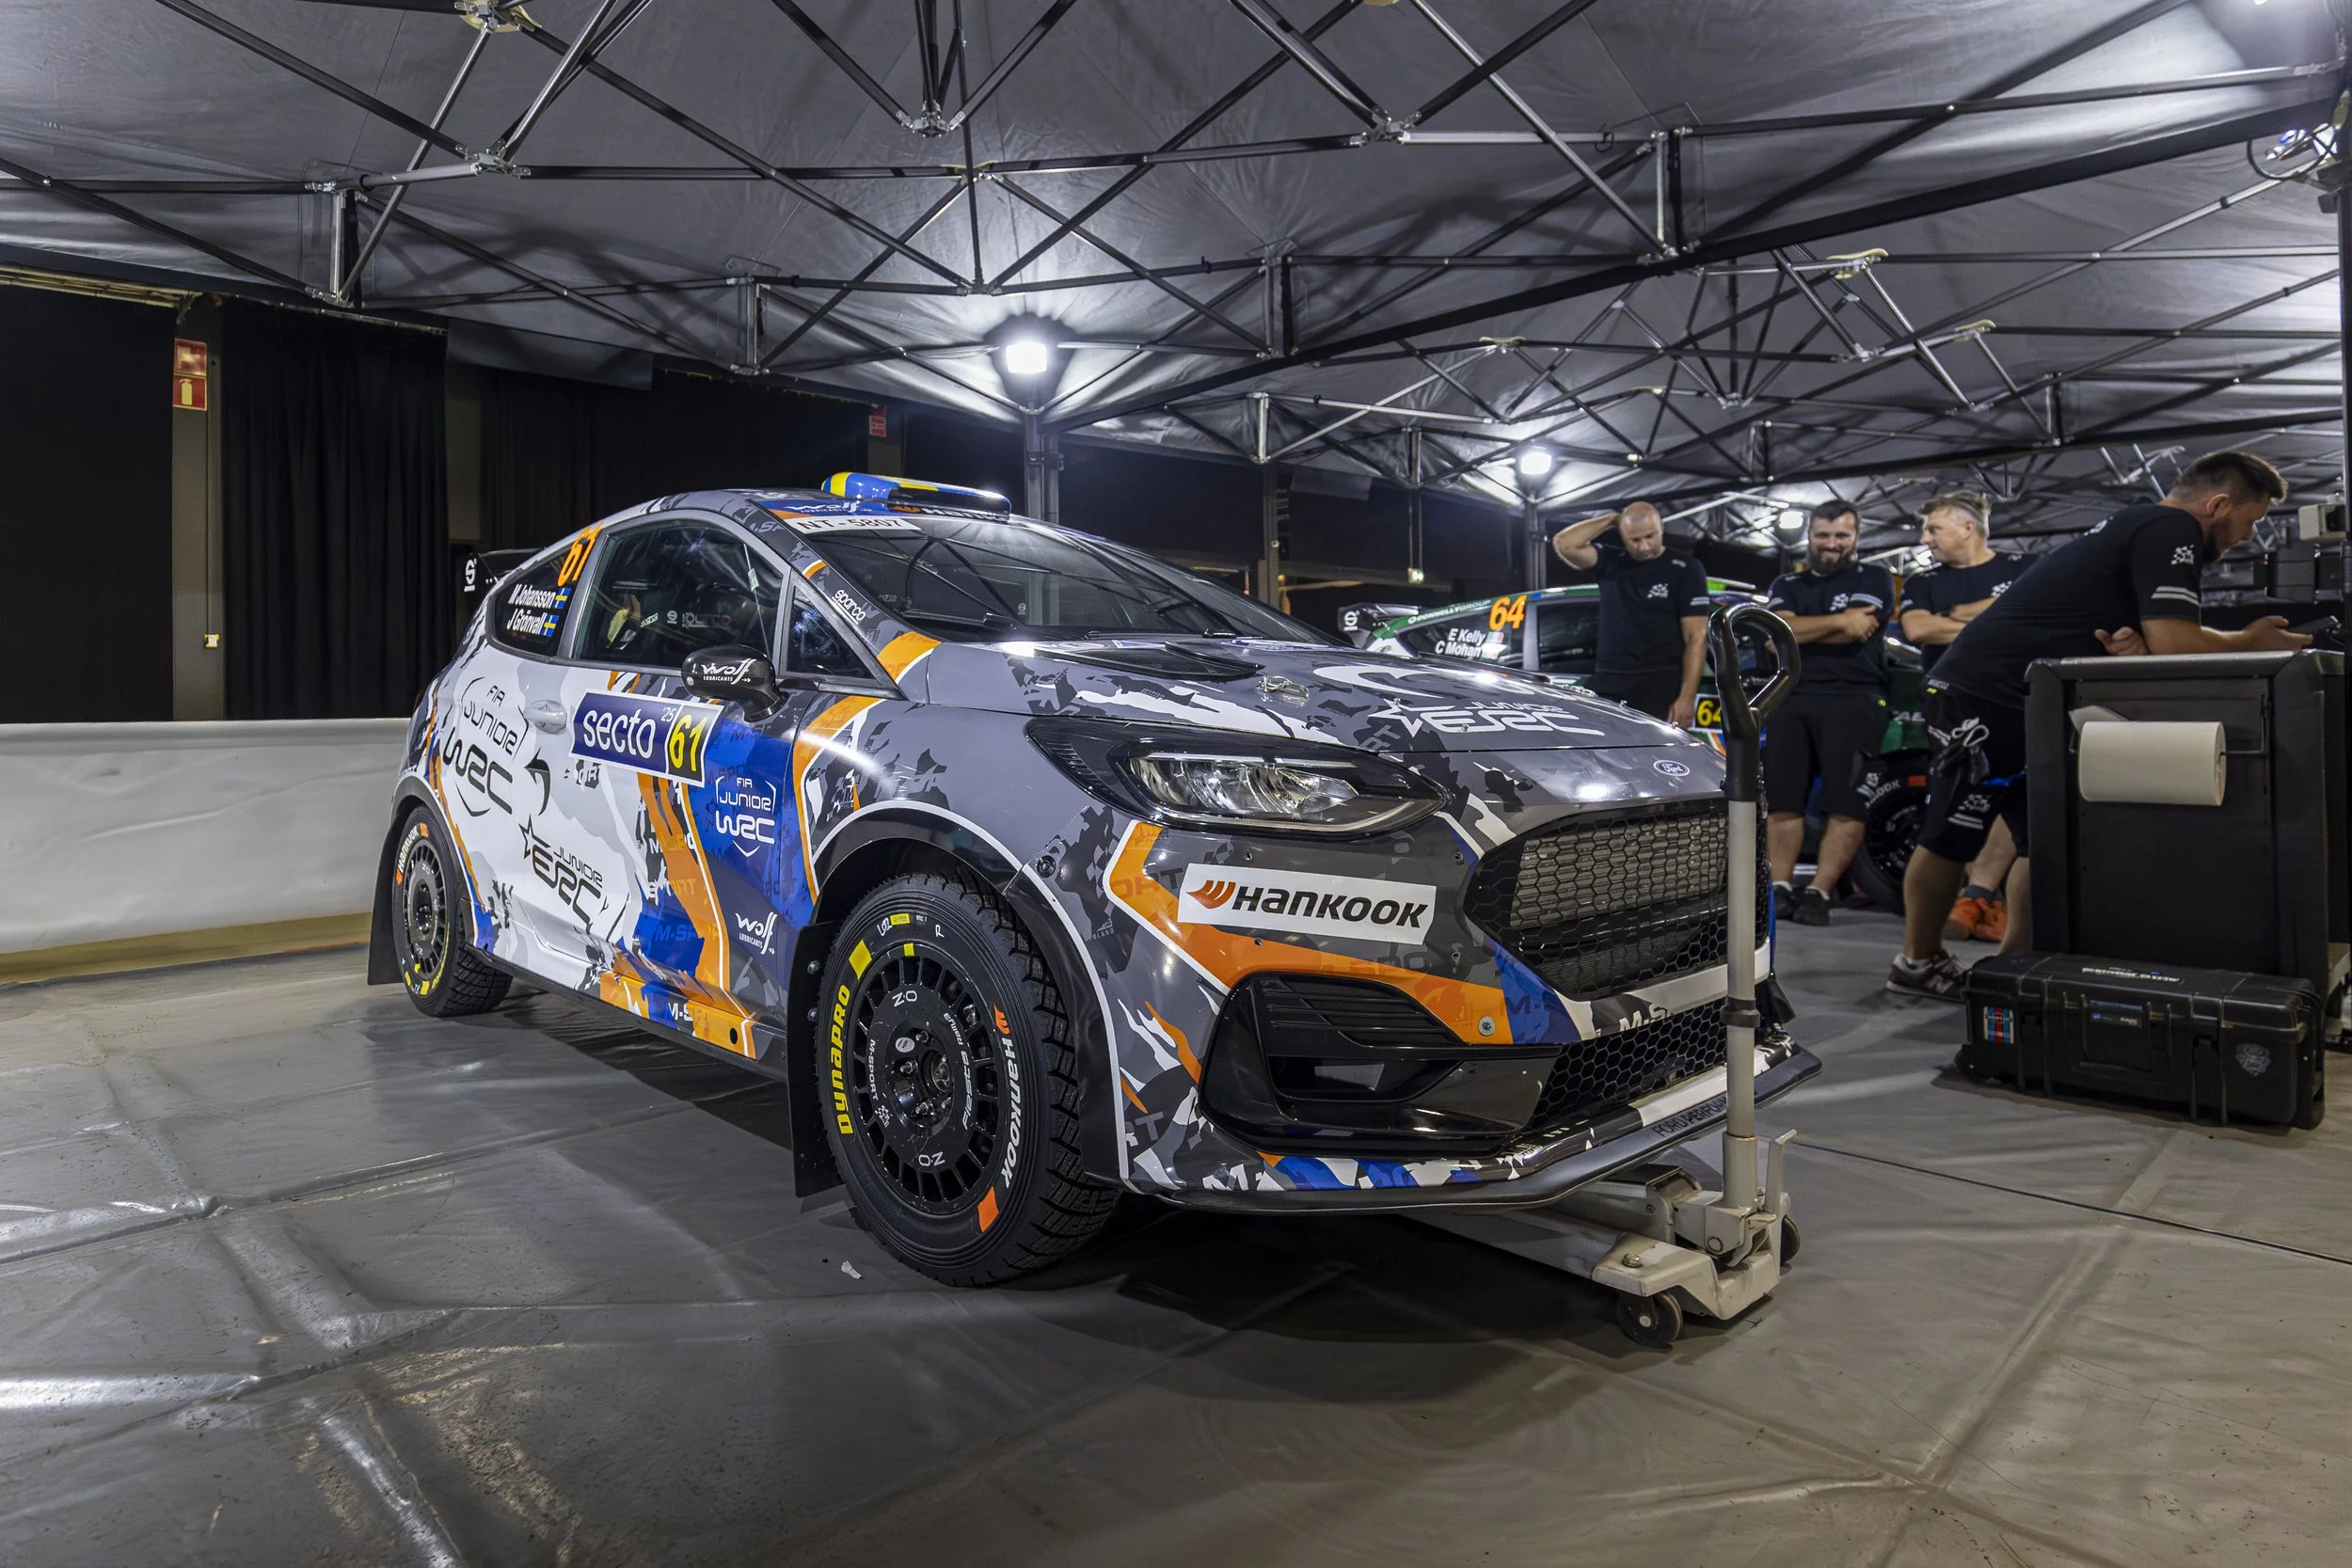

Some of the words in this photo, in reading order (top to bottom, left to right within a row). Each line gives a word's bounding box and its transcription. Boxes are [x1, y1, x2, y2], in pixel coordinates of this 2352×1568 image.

[515, 584, 557, 610] Johansson
[834, 589, 866, 623] sparco
[1488, 594, 1527, 631] 64
[1435, 641, 1446, 654] C
[1448, 627, 1458, 641] E
[1458, 628, 1486, 646] Kelly
[701, 657, 756, 685] Wolf
[486, 685, 506, 707] FIA
[464, 700, 518, 755] JUNIOR
[582, 708, 657, 759] secto
[669, 714, 708, 772] 61
[443, 725, 514, 816] WRC
[737, 777, 753, 789] FIA
[1661, 762, 1684, 773] Ford
[719, 791, 771, 812] JUNIOR
[715, 810, 775, 845] WRC
[553, 847, 603, 889] JUNIOR
[735, 911, 778, 955] Wolf
[739, 933, 764, 949] LUBRICANTS
